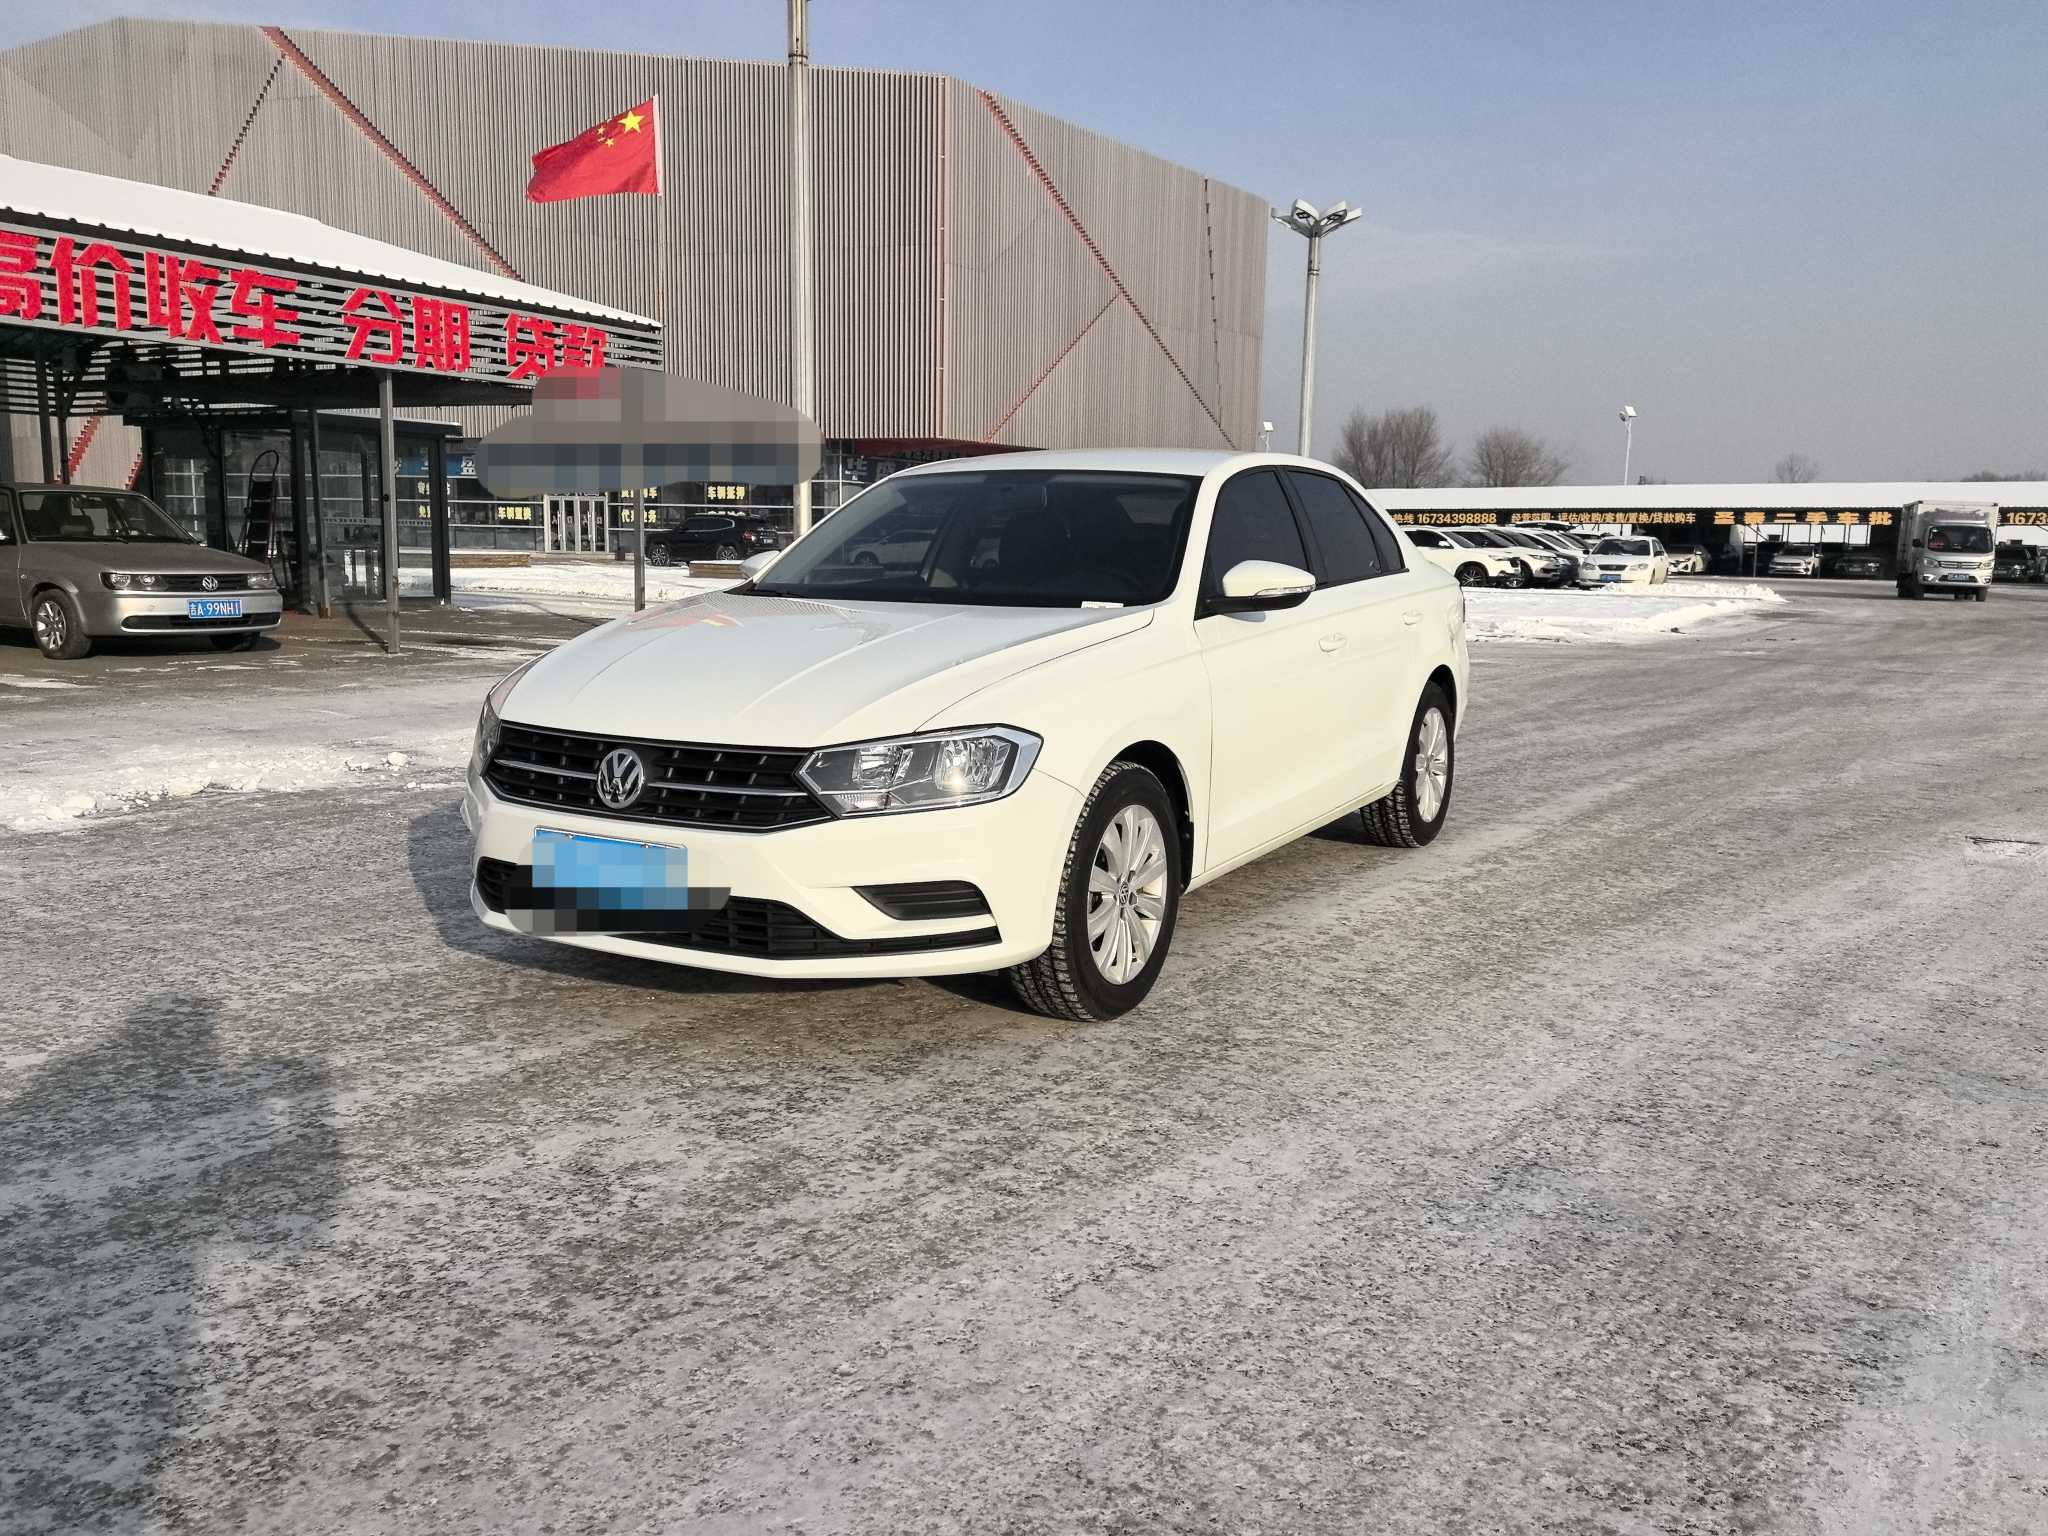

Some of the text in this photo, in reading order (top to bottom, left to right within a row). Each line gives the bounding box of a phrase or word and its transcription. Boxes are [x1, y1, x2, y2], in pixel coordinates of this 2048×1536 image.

[337, 287, 470, 373] 分期
[1417, 512, 1497, 524] 16734398888
[2007, 512, 2048, 525] 1673
